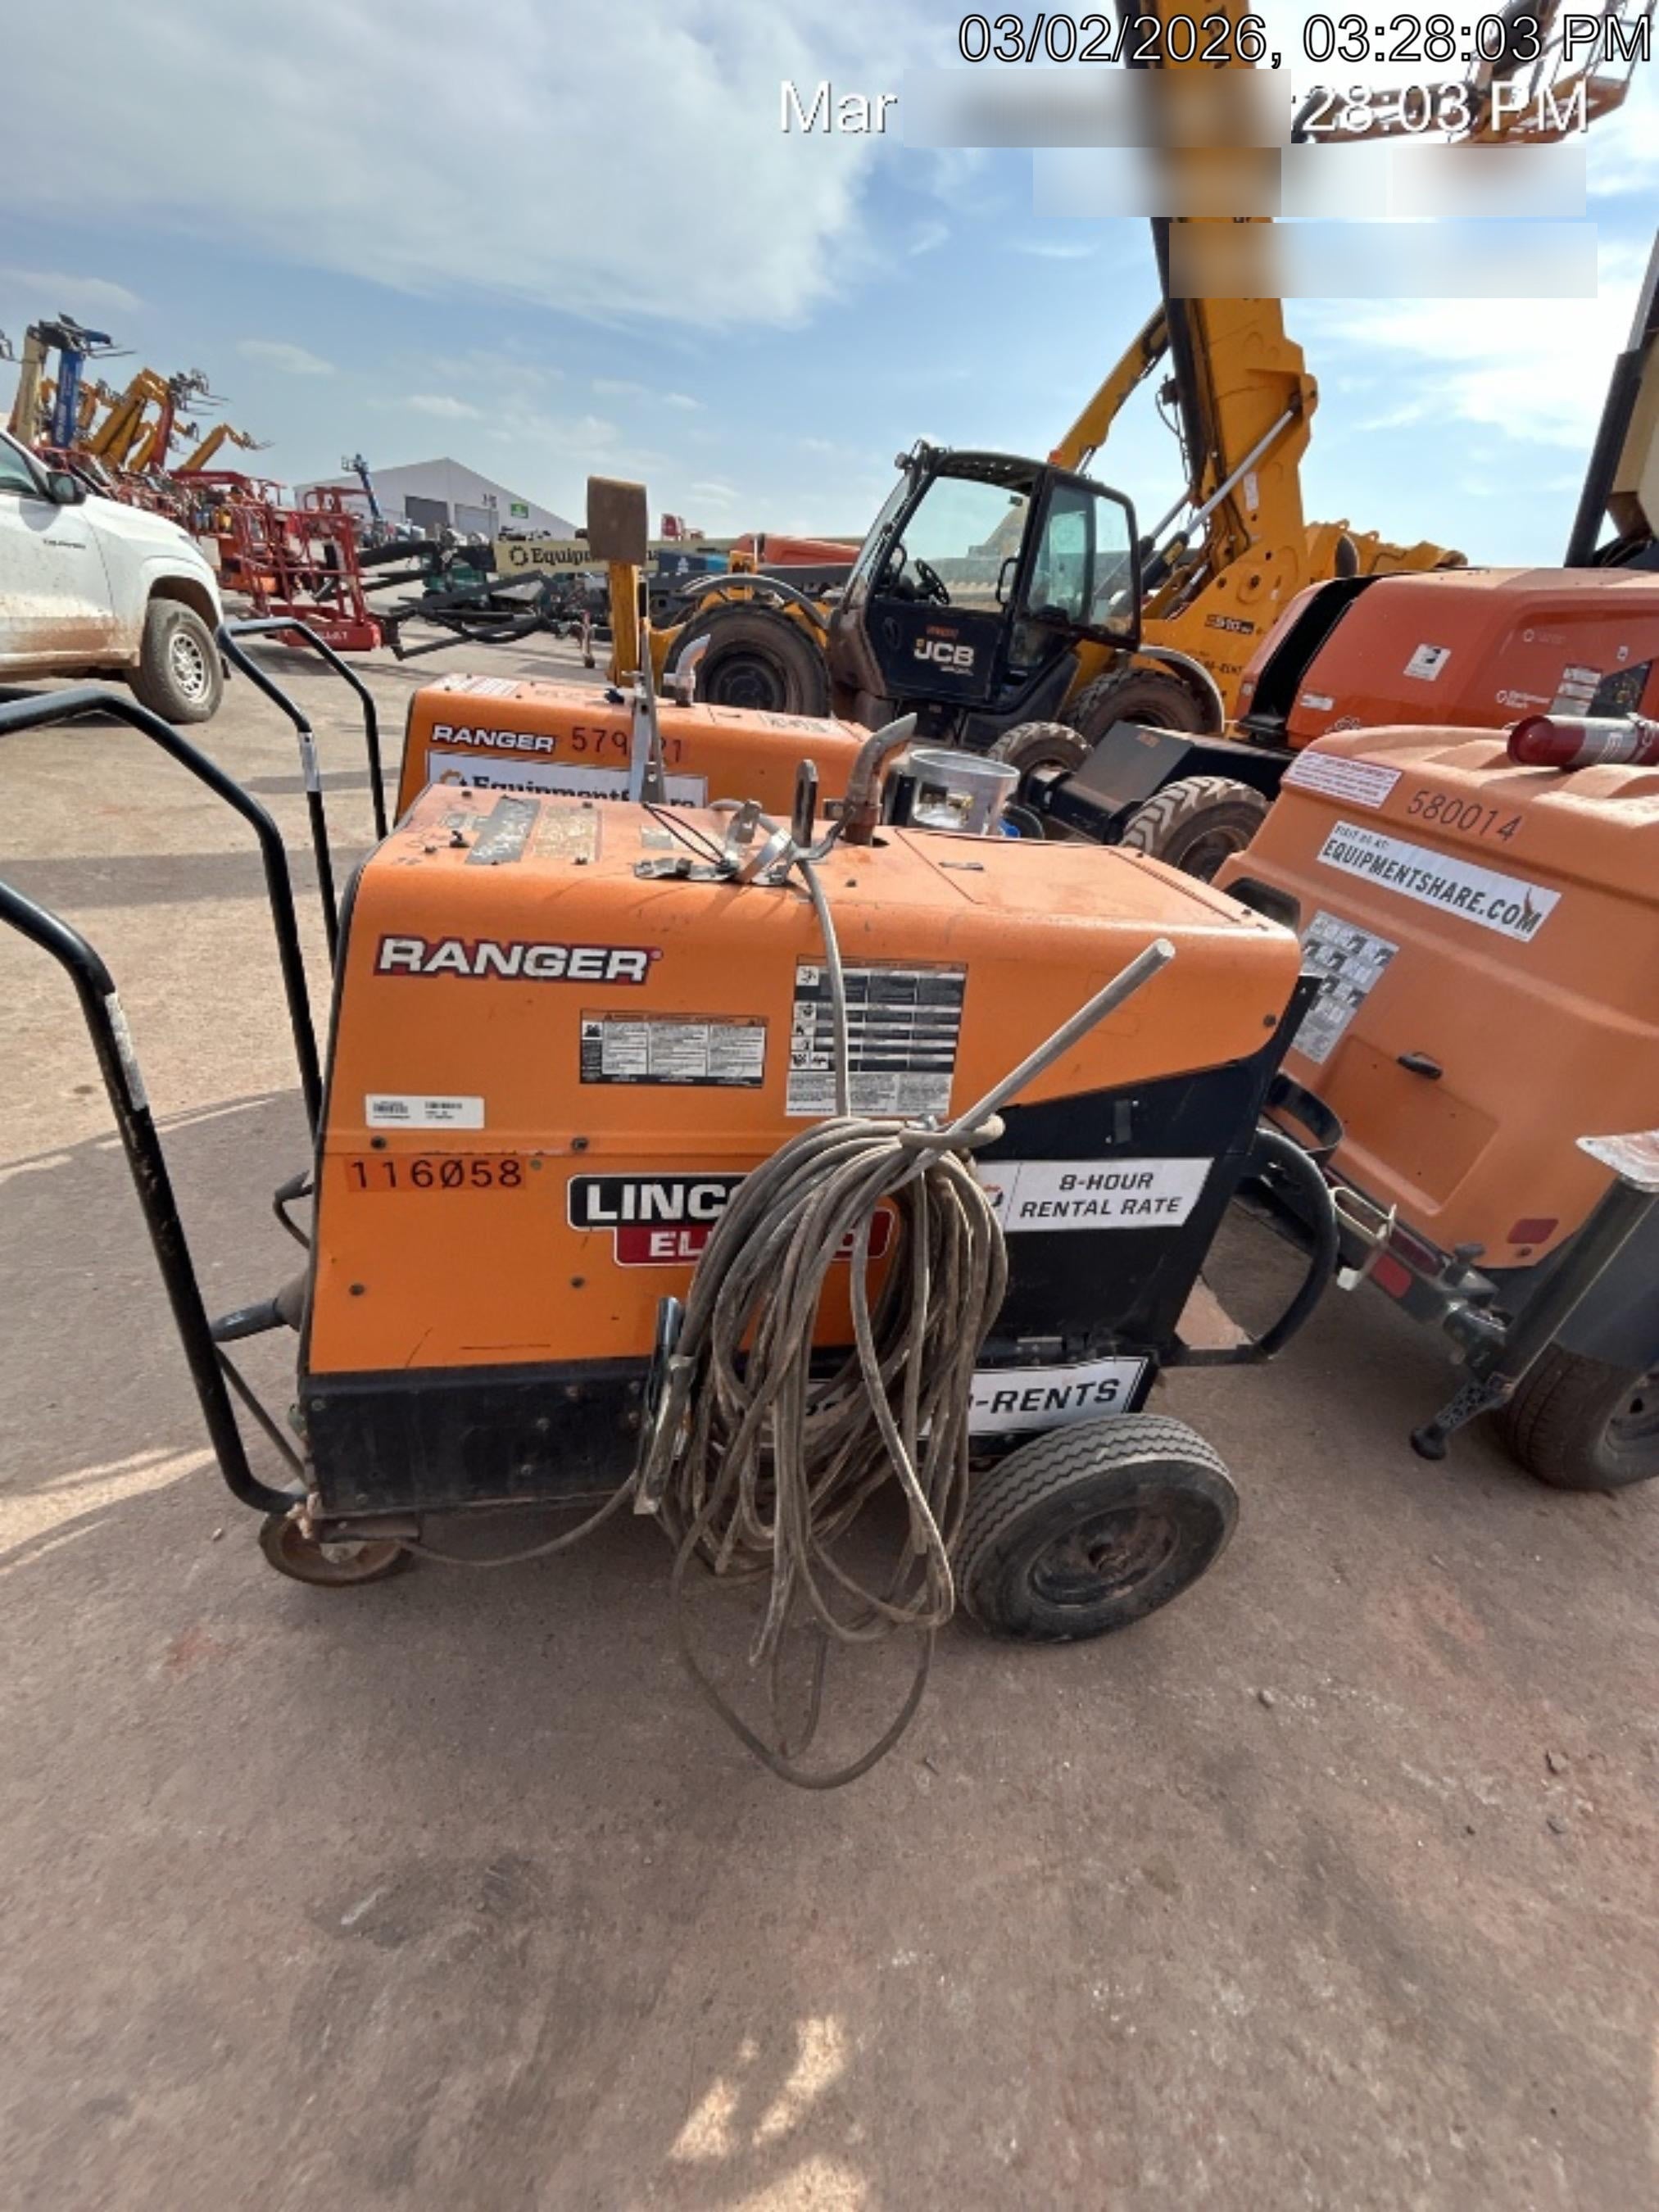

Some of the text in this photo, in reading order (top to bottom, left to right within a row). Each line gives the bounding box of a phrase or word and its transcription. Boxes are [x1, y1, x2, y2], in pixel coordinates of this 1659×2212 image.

[913, 640, 975, 667] JCB
[432, 724, 555, 753] RANGER
[1407, 791, 1522, 842] 580014
[1322, 839, 1542, 934] EQUIPMENTSHARE.COM
[379, 937, 648, 982] RANGER
[1059, 1172, 1154, 1190] 8-HOUR
[587, 1184, 732, 1221] LINC
[1020, 1196, 1182, 1217] RENTAL RATE
[969, 1378, 1120, 1414] -RENTS
